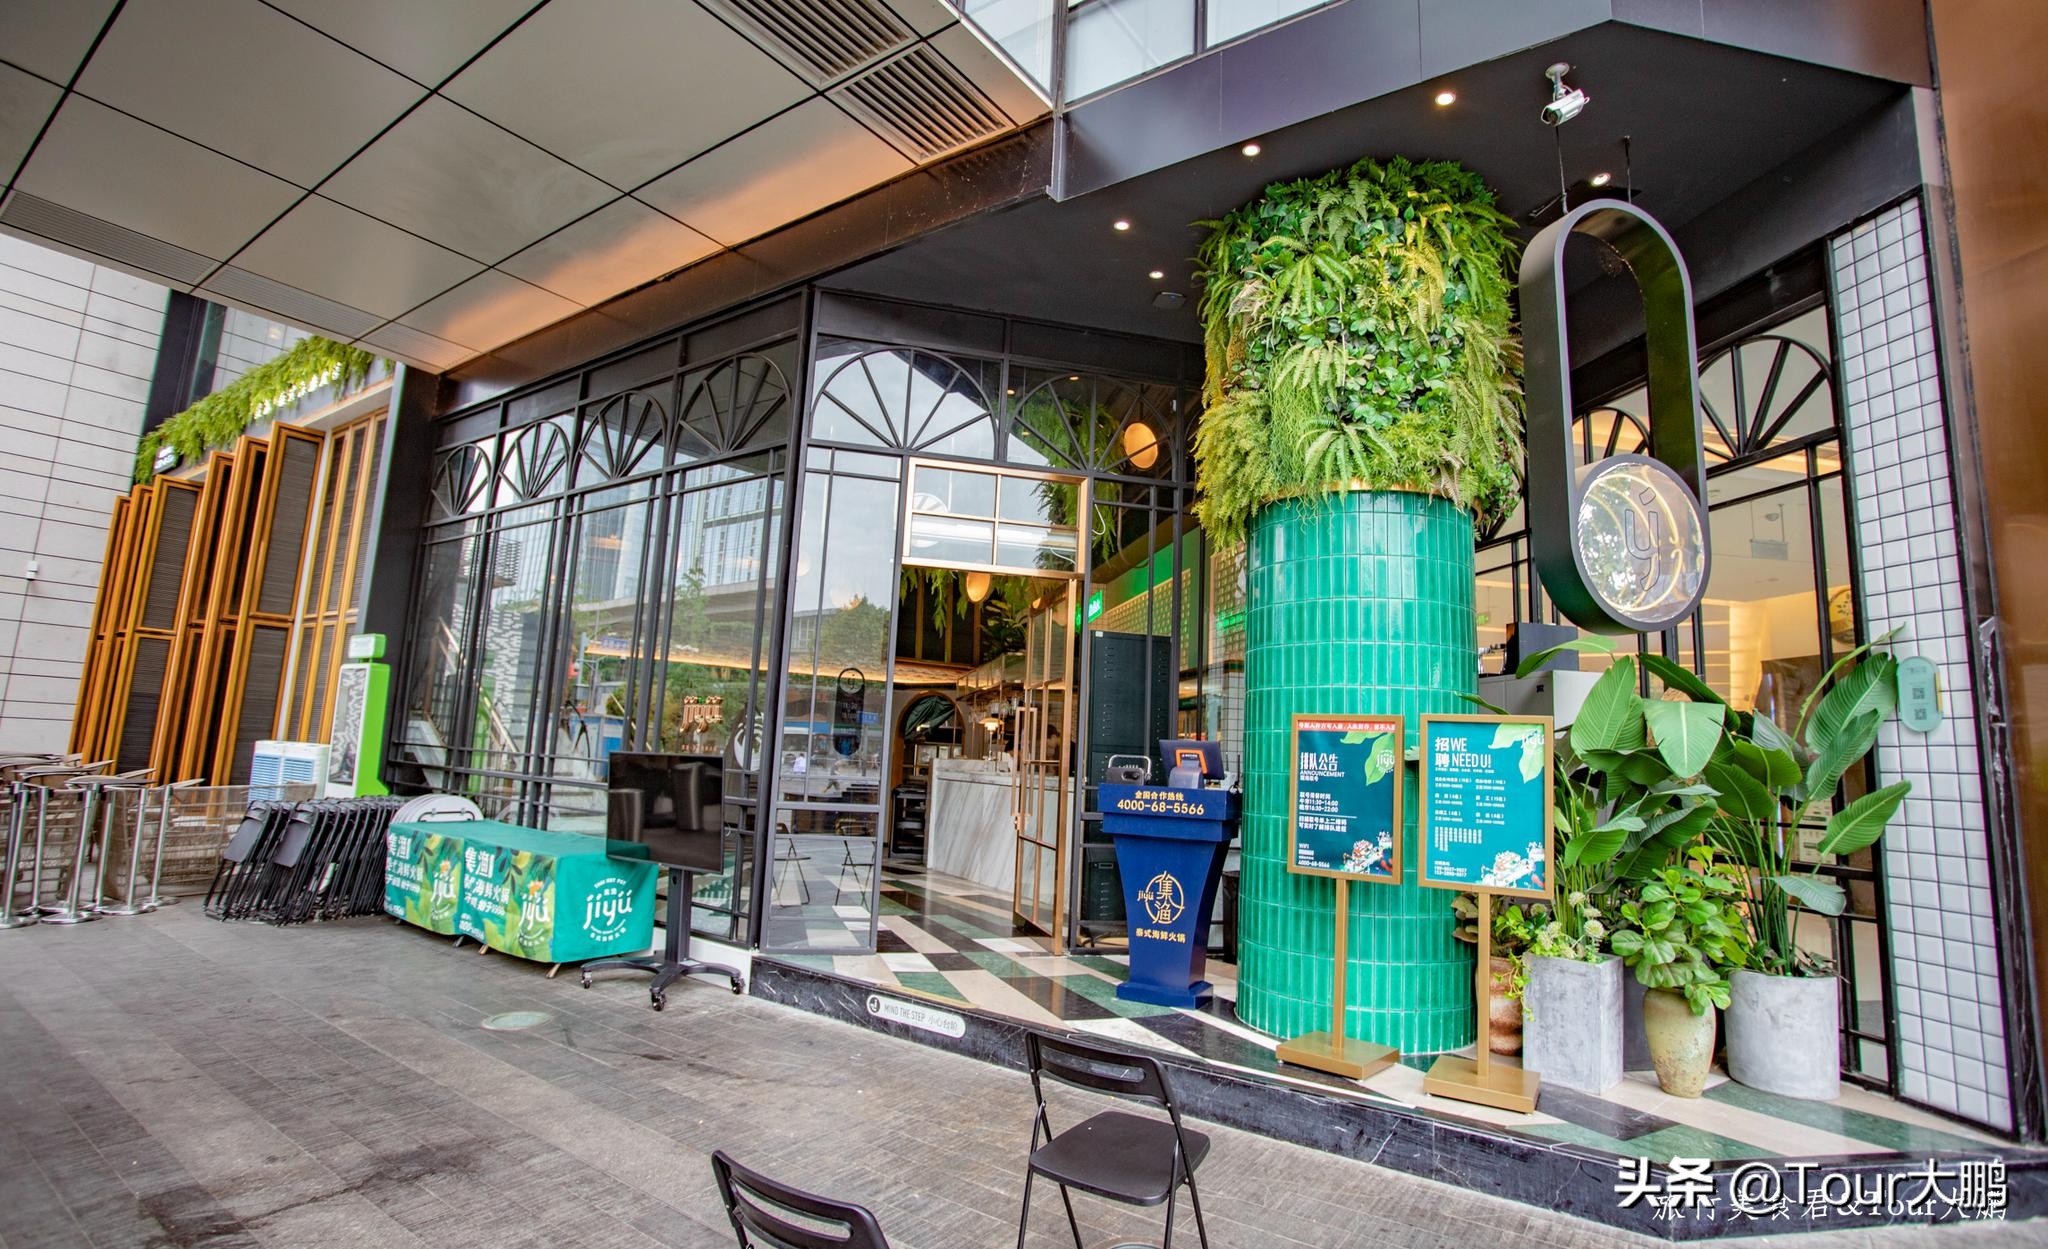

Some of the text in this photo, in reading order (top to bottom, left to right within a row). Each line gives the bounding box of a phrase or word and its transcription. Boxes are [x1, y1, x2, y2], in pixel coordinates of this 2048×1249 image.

[1450, 737, 1467, 752] WE
[1300, 752, 1338, 771] 排队公告
[1452, 753, 1479, 768] NEED
[1480, 754, 1492, 769] U!
[1300, 770, 1345, 778] ANNOUNCEMENT
[1117, 799, 1205, 816] 4000-68-5566
[884, 1003, 899, 1015] MIND
[899, 1007, 910, 1018] THE
[911, 1010, 926, 1023] STEP
